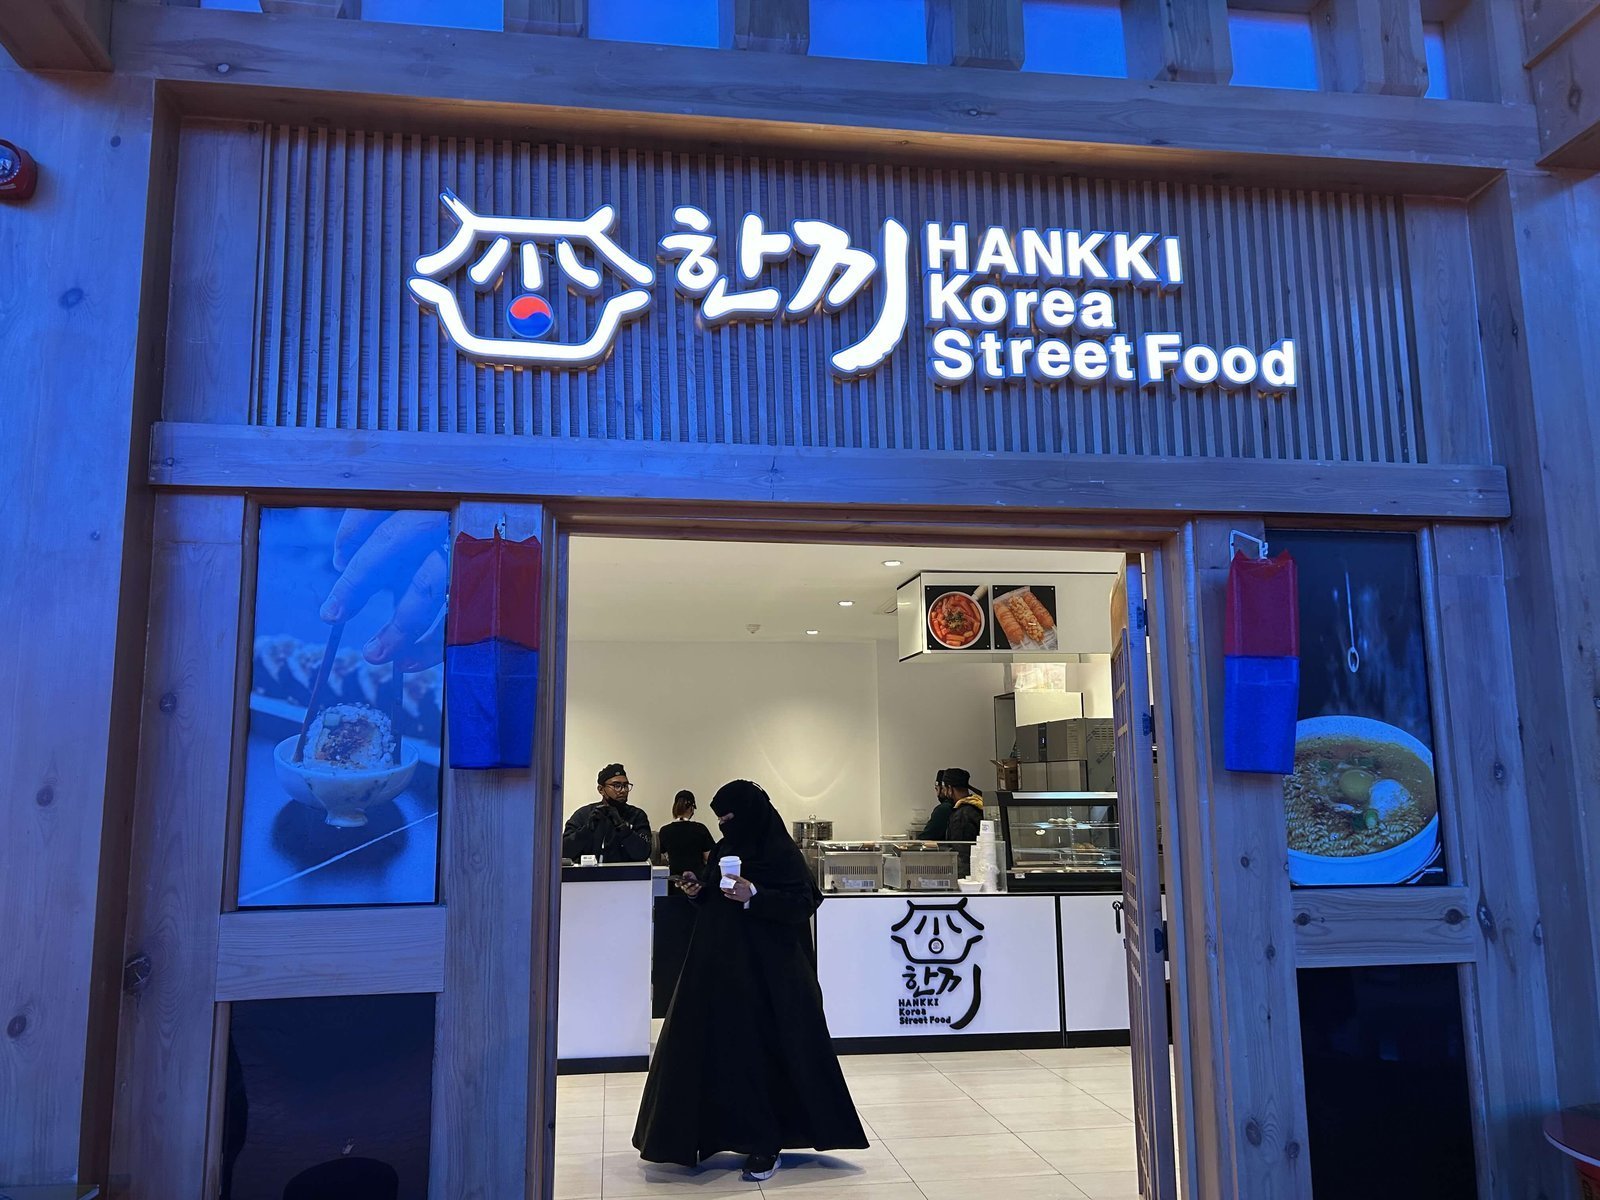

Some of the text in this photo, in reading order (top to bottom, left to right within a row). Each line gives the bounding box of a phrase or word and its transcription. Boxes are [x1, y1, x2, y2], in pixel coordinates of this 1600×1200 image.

[926, 222, 1182, 283] HANKKI
[660, 206, 909, 372] 한끼
[928, 272, 1115, 329] Korea
[932, 329, 1297, 388] Street Food
[898, 998, 940, 1007] HANKKI
[898, 1007, 927, 1016] Korea
[899, 1015, 952, 1025] Street Food
[902, 963, 982, 1030] 한끼
